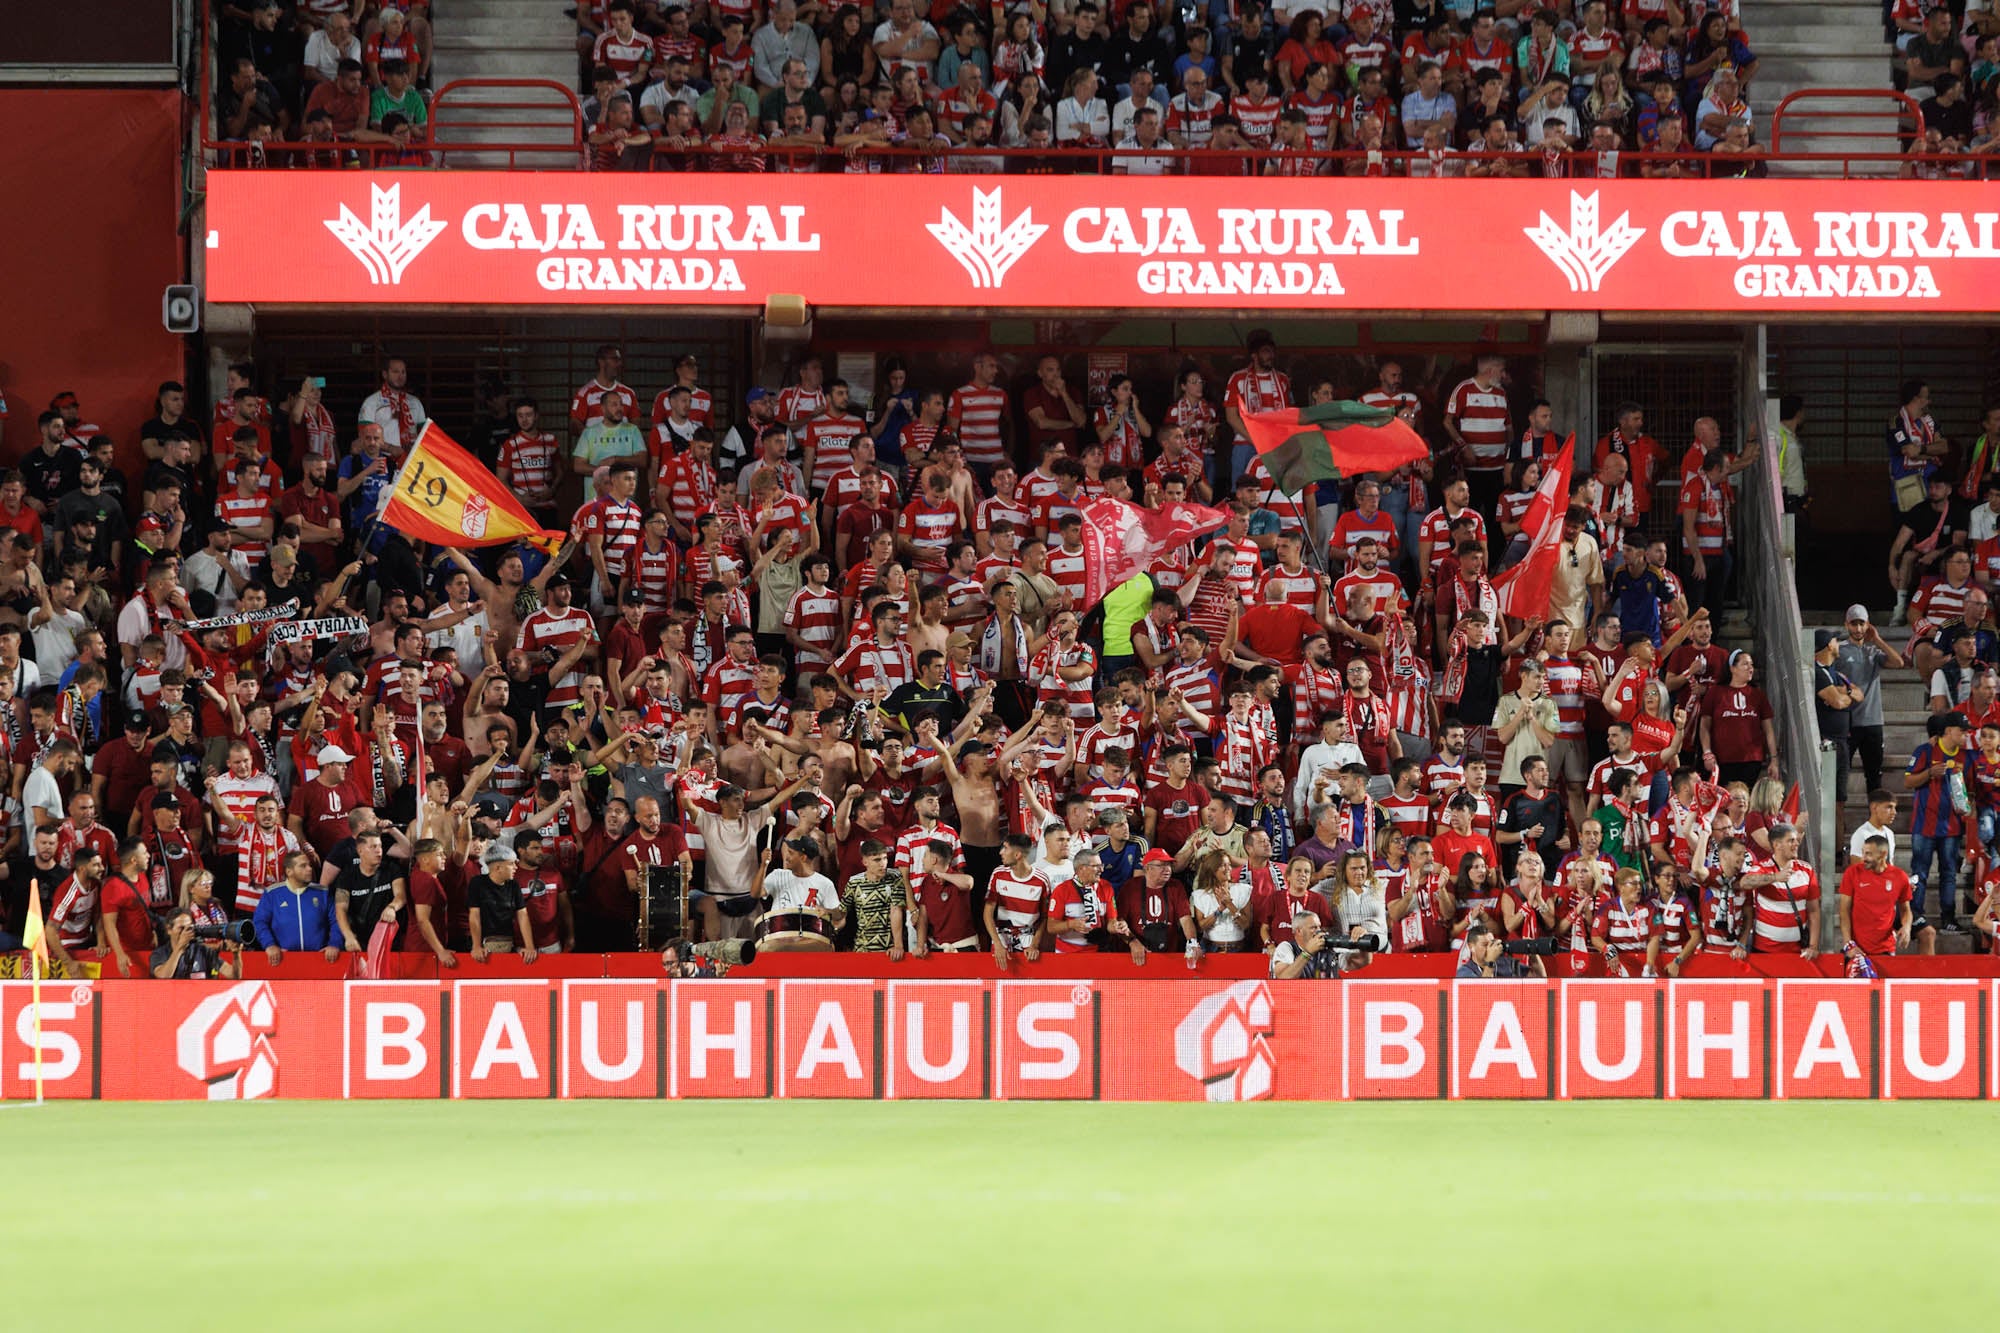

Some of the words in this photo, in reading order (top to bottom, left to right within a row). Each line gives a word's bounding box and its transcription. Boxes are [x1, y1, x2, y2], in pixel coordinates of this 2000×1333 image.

[462, 204, 605, 251] CAJA
[618, 205, 820, 251] RURAL
[1064, 208, 1205, 255] CAJA
[1218, 209, 1419, 255] RURAL
[1661, 211, 1801, 258] CAJA
[1814, 212, 2000, 258] RURAL
[537, 258, 745, 291] GRANADA
[1138, 262, 1345, 295] GRANADA
[1734, 265, 1940, 298] GRANADA
[1364, 1001, 1967, 1083] BAUHAU
